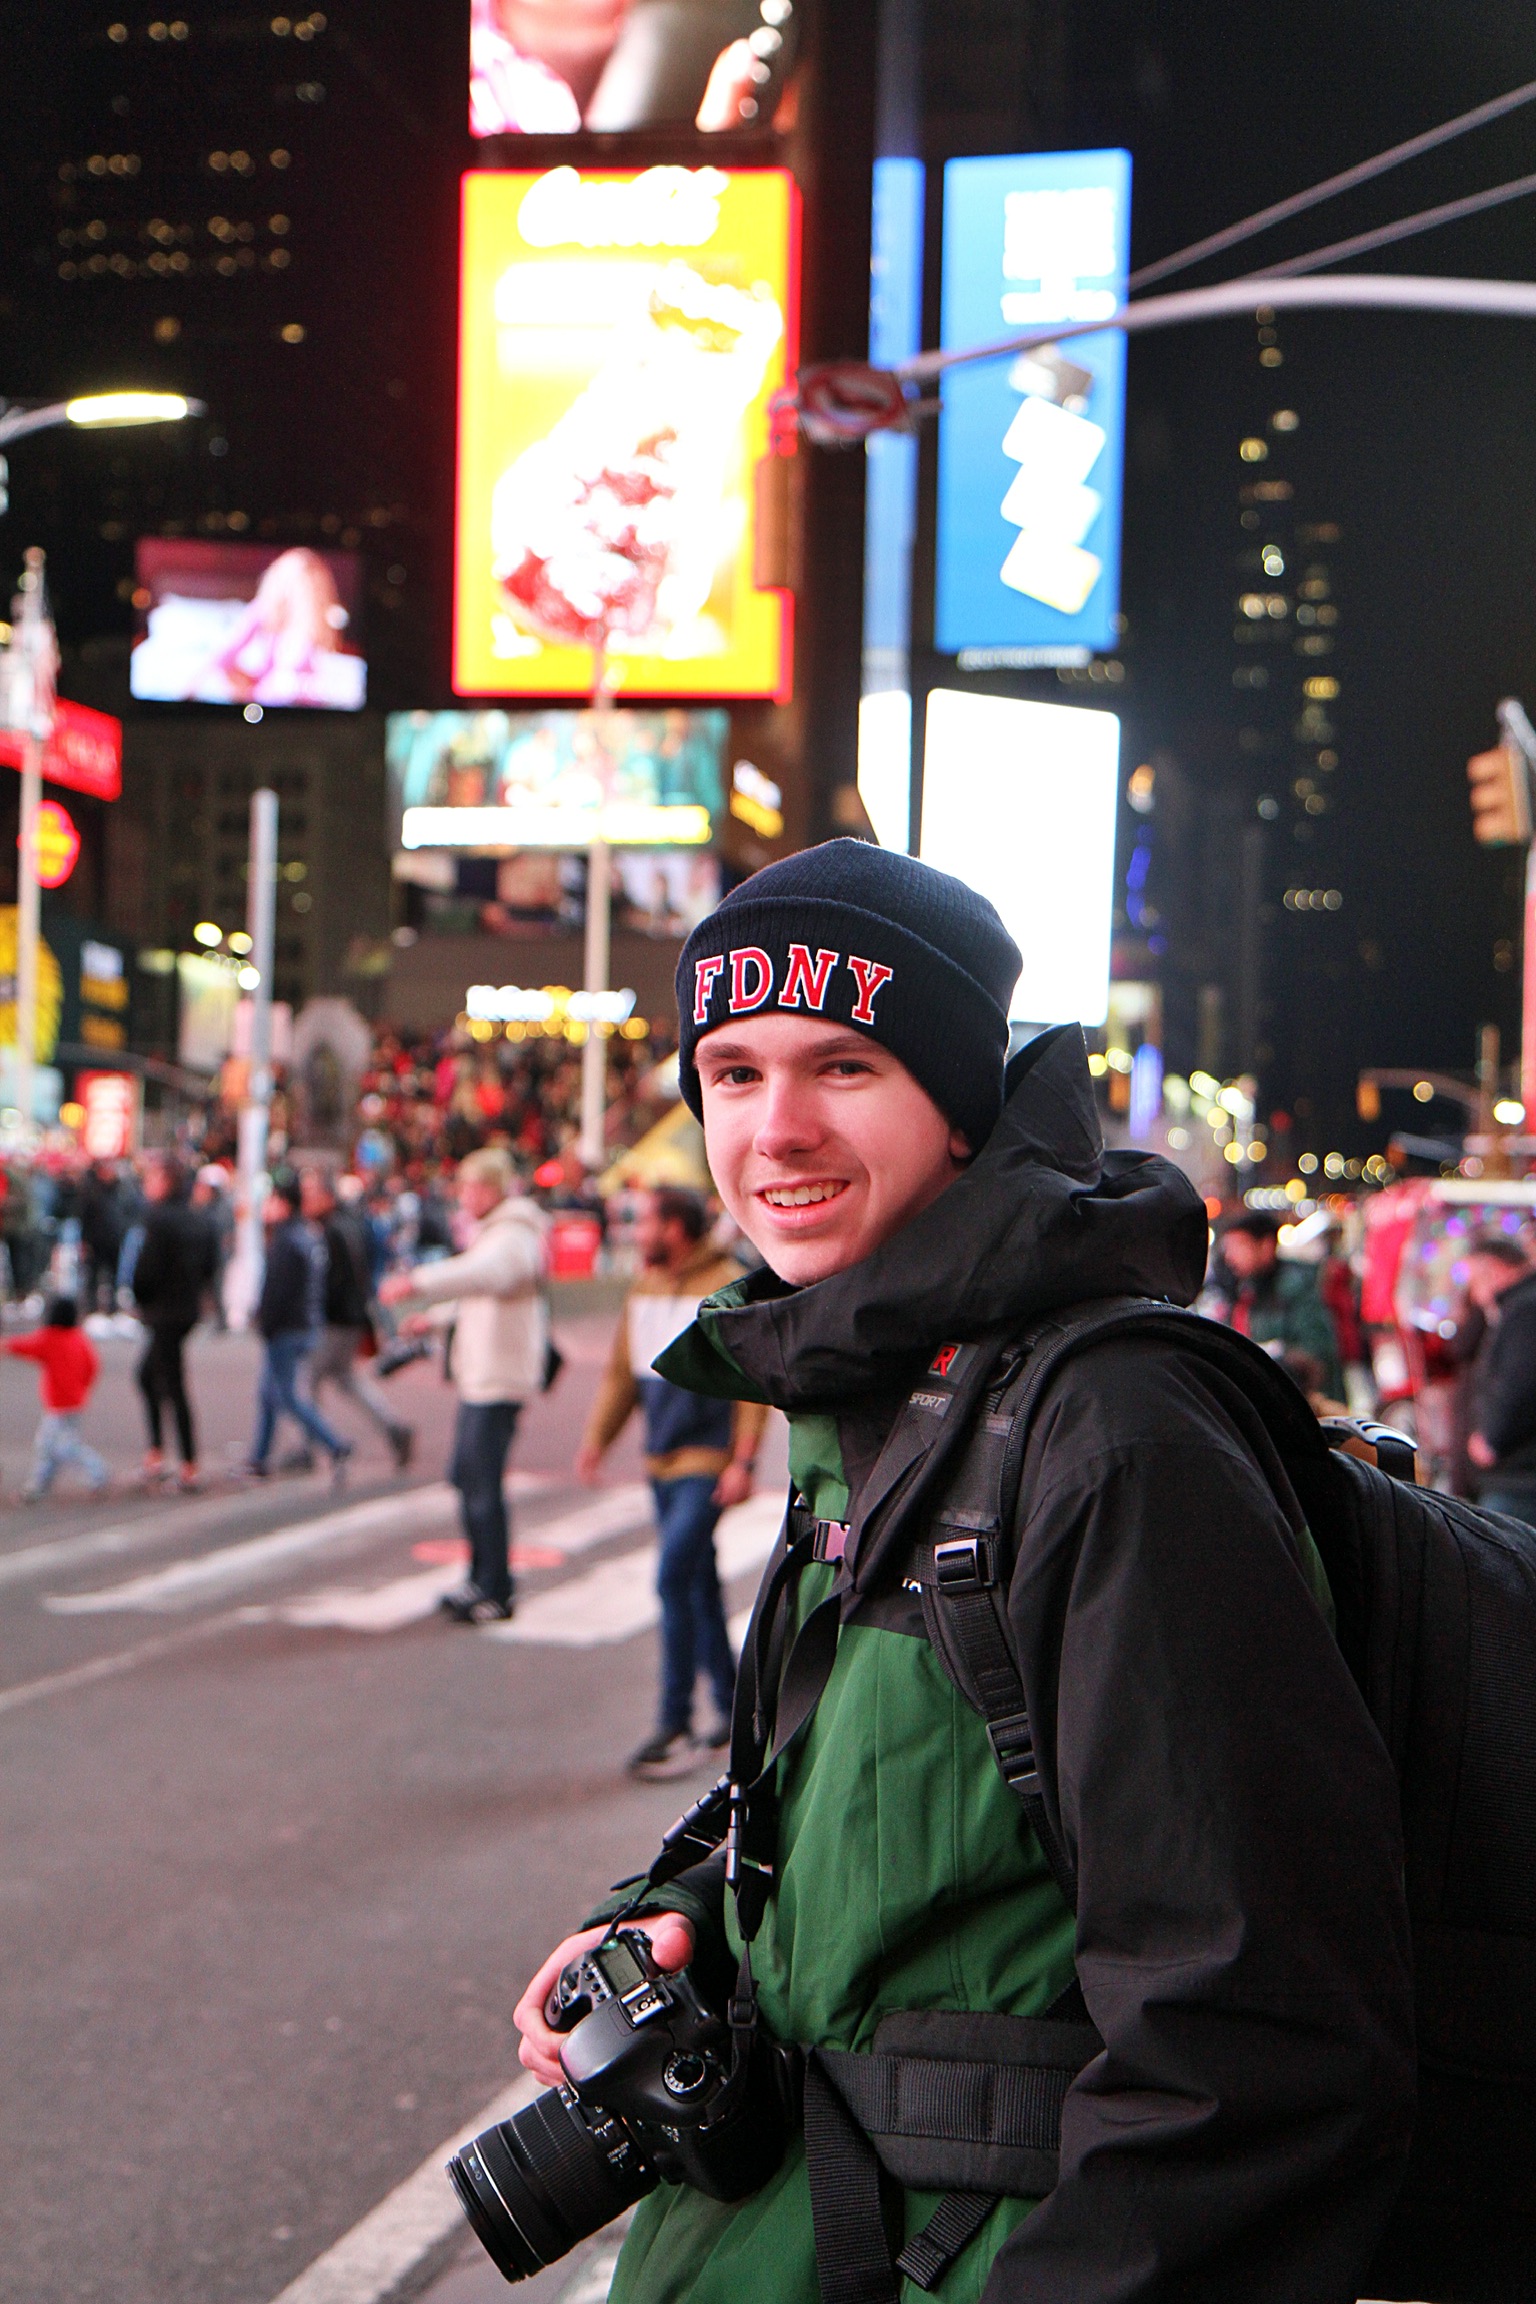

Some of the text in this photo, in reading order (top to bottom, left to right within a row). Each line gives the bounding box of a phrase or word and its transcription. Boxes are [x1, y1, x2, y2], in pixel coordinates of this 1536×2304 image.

[693, 943, 894, 1025] FDNY
[933, 1346, 956, 1377] R
[909, 1392, 946, 1408] SPORT
